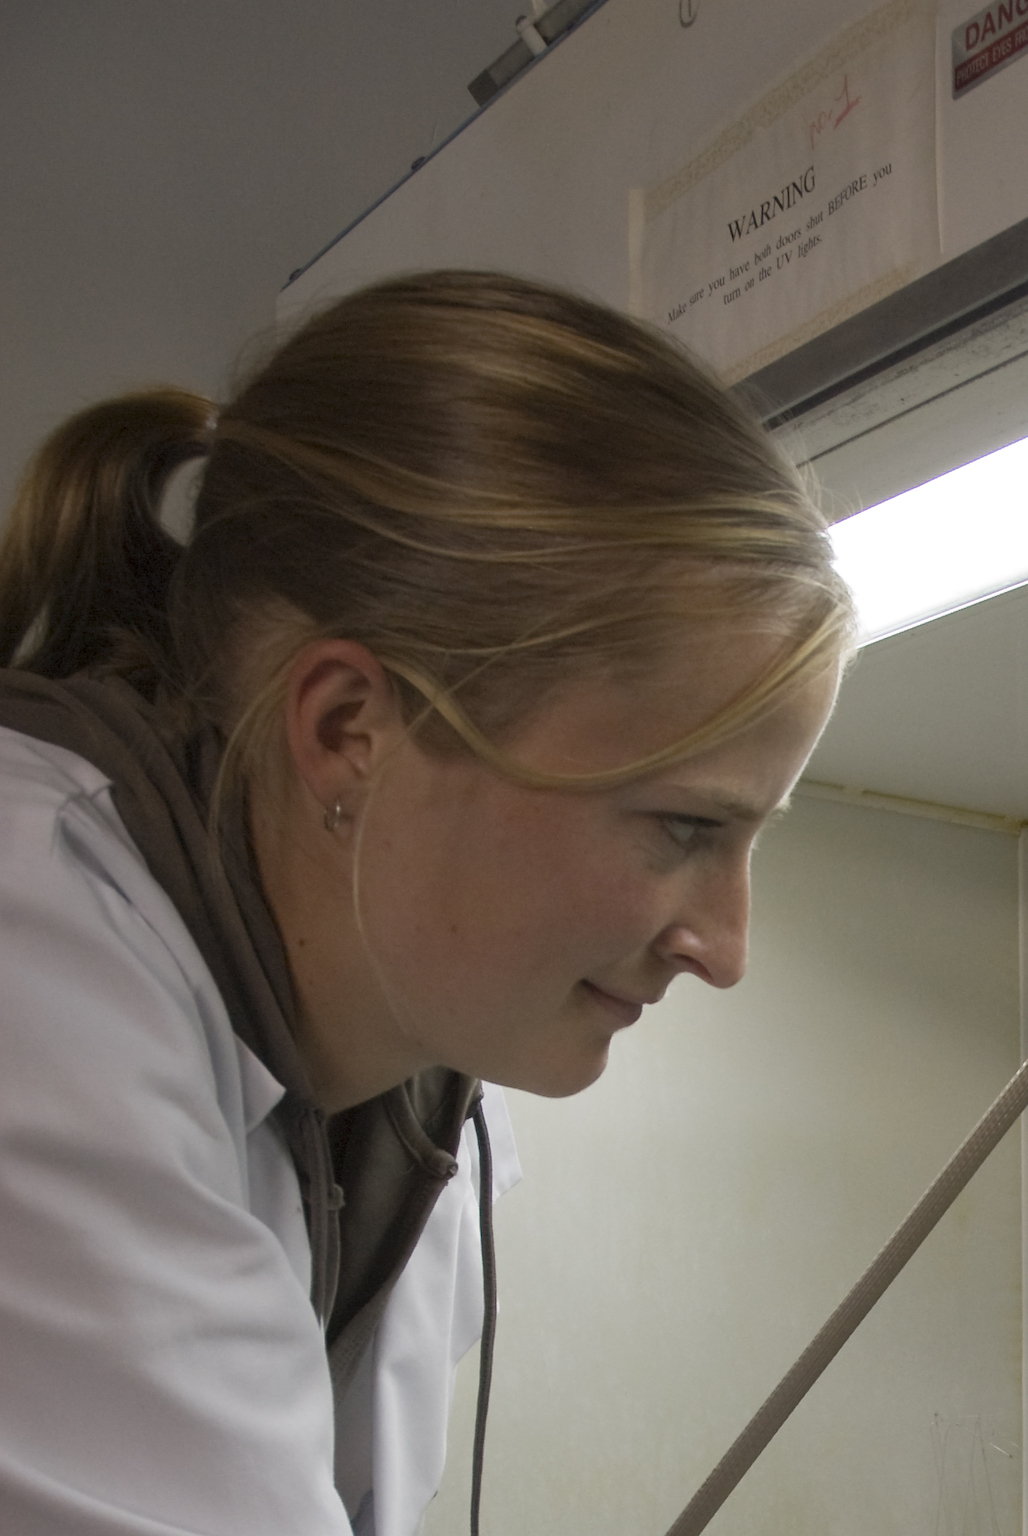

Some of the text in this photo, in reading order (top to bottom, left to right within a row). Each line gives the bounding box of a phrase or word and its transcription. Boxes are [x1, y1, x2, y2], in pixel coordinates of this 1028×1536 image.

[956, 51, 992, 85] PROTECT
[992, 37, 1013, 61] EYES
[727, 166, 816, 243] WARNING
[668, 163, 893, 325] Make sure you have both doors shut BEFORE you
[723, 233, 823, 306] turn on the UV lights.
